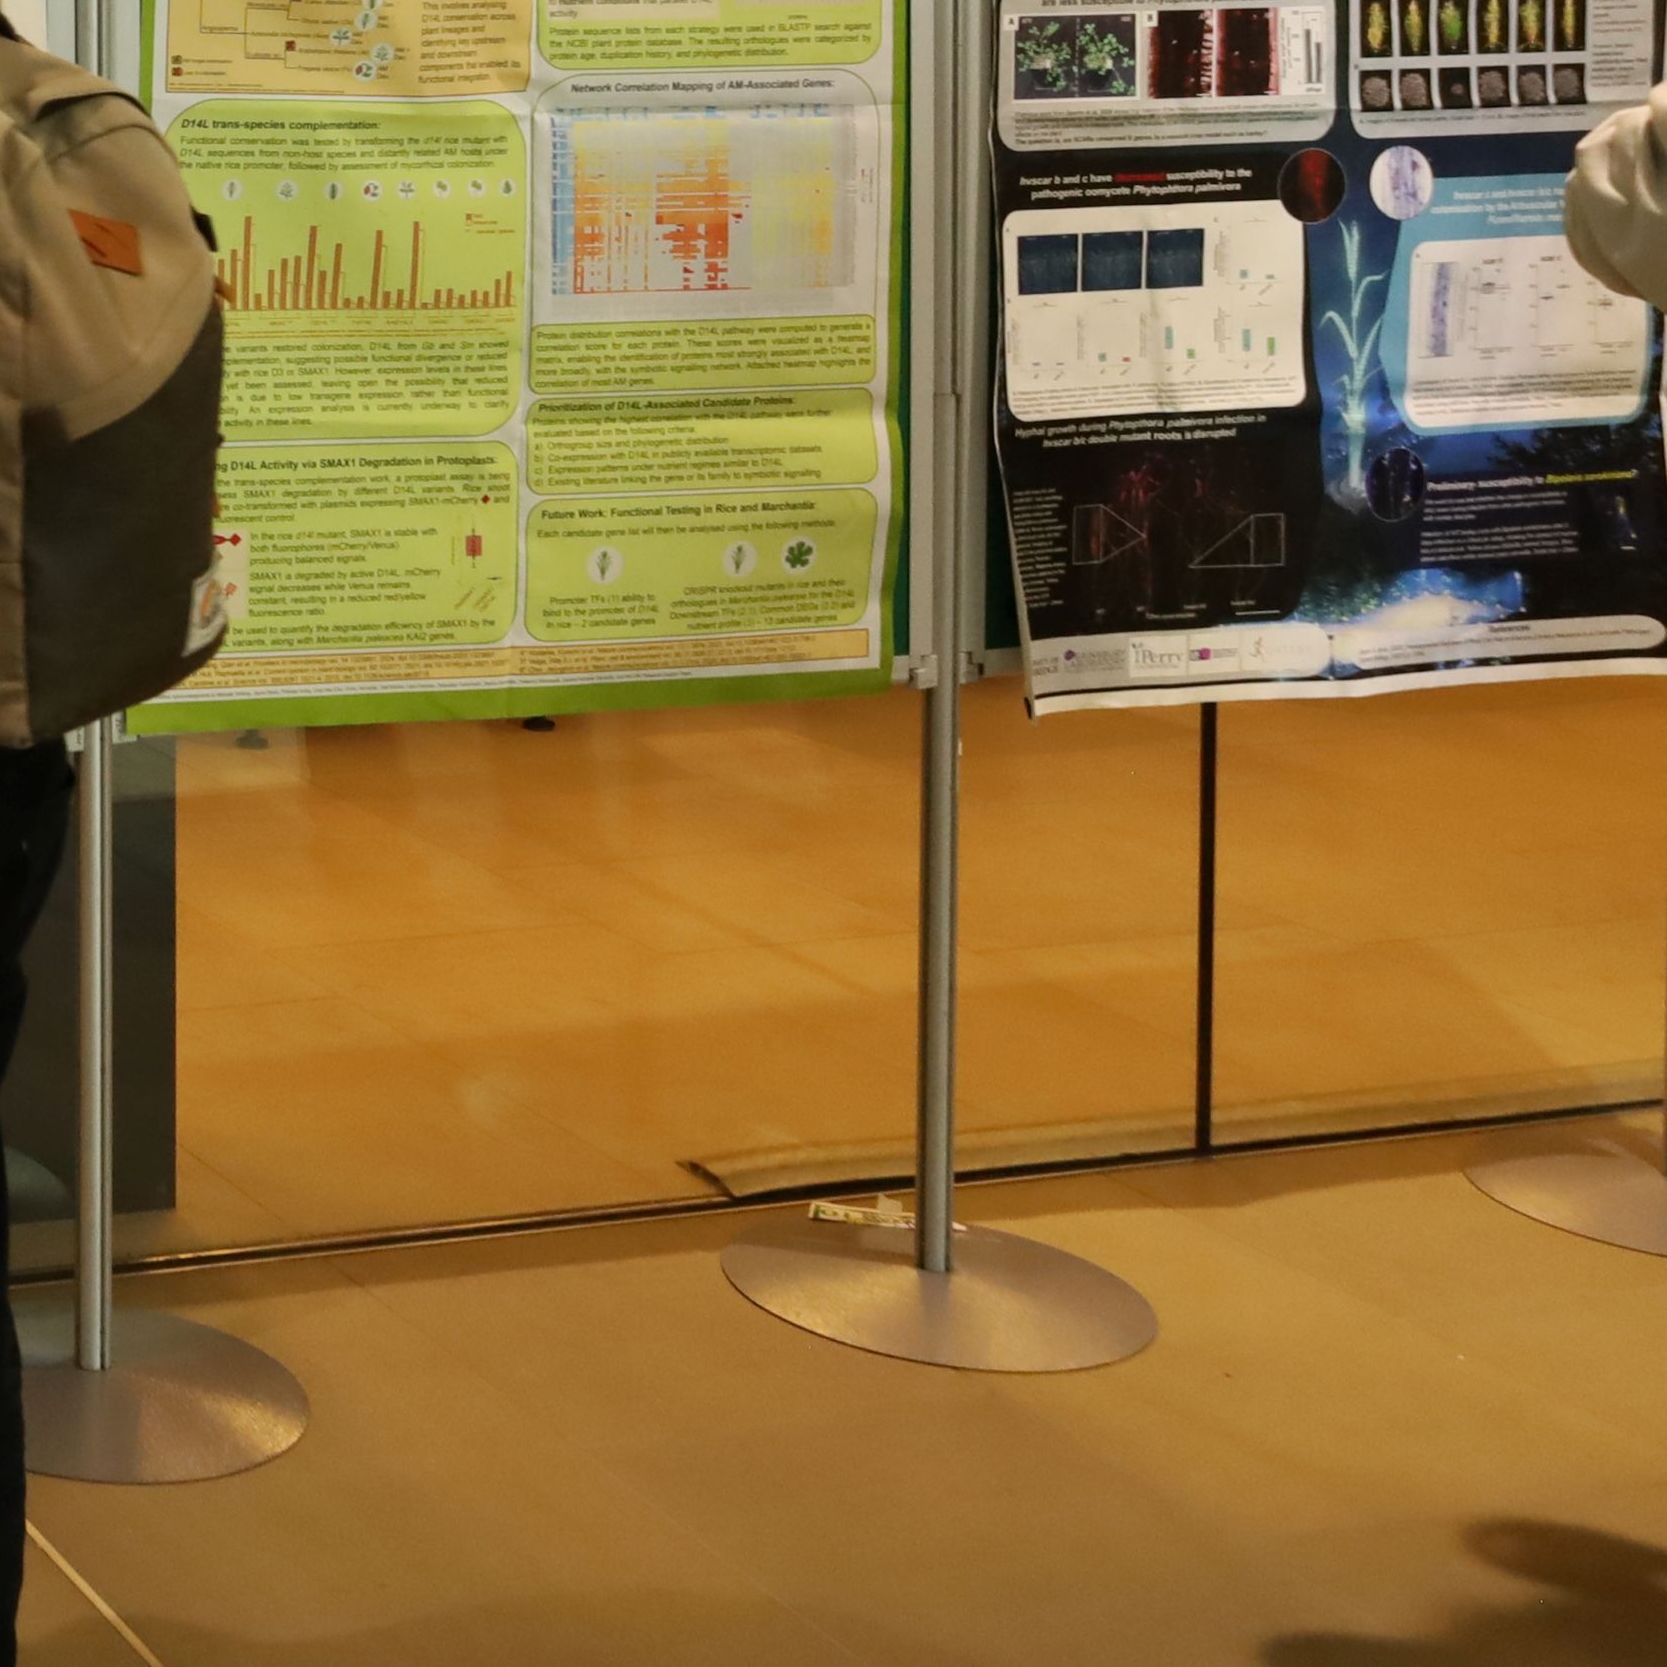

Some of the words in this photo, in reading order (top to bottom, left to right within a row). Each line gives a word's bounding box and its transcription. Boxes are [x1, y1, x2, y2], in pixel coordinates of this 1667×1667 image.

[180, 117, 210, 130] D14L
[211, 119, 287, 132] trans-species
[288, 119, 381, 133] complementation:
